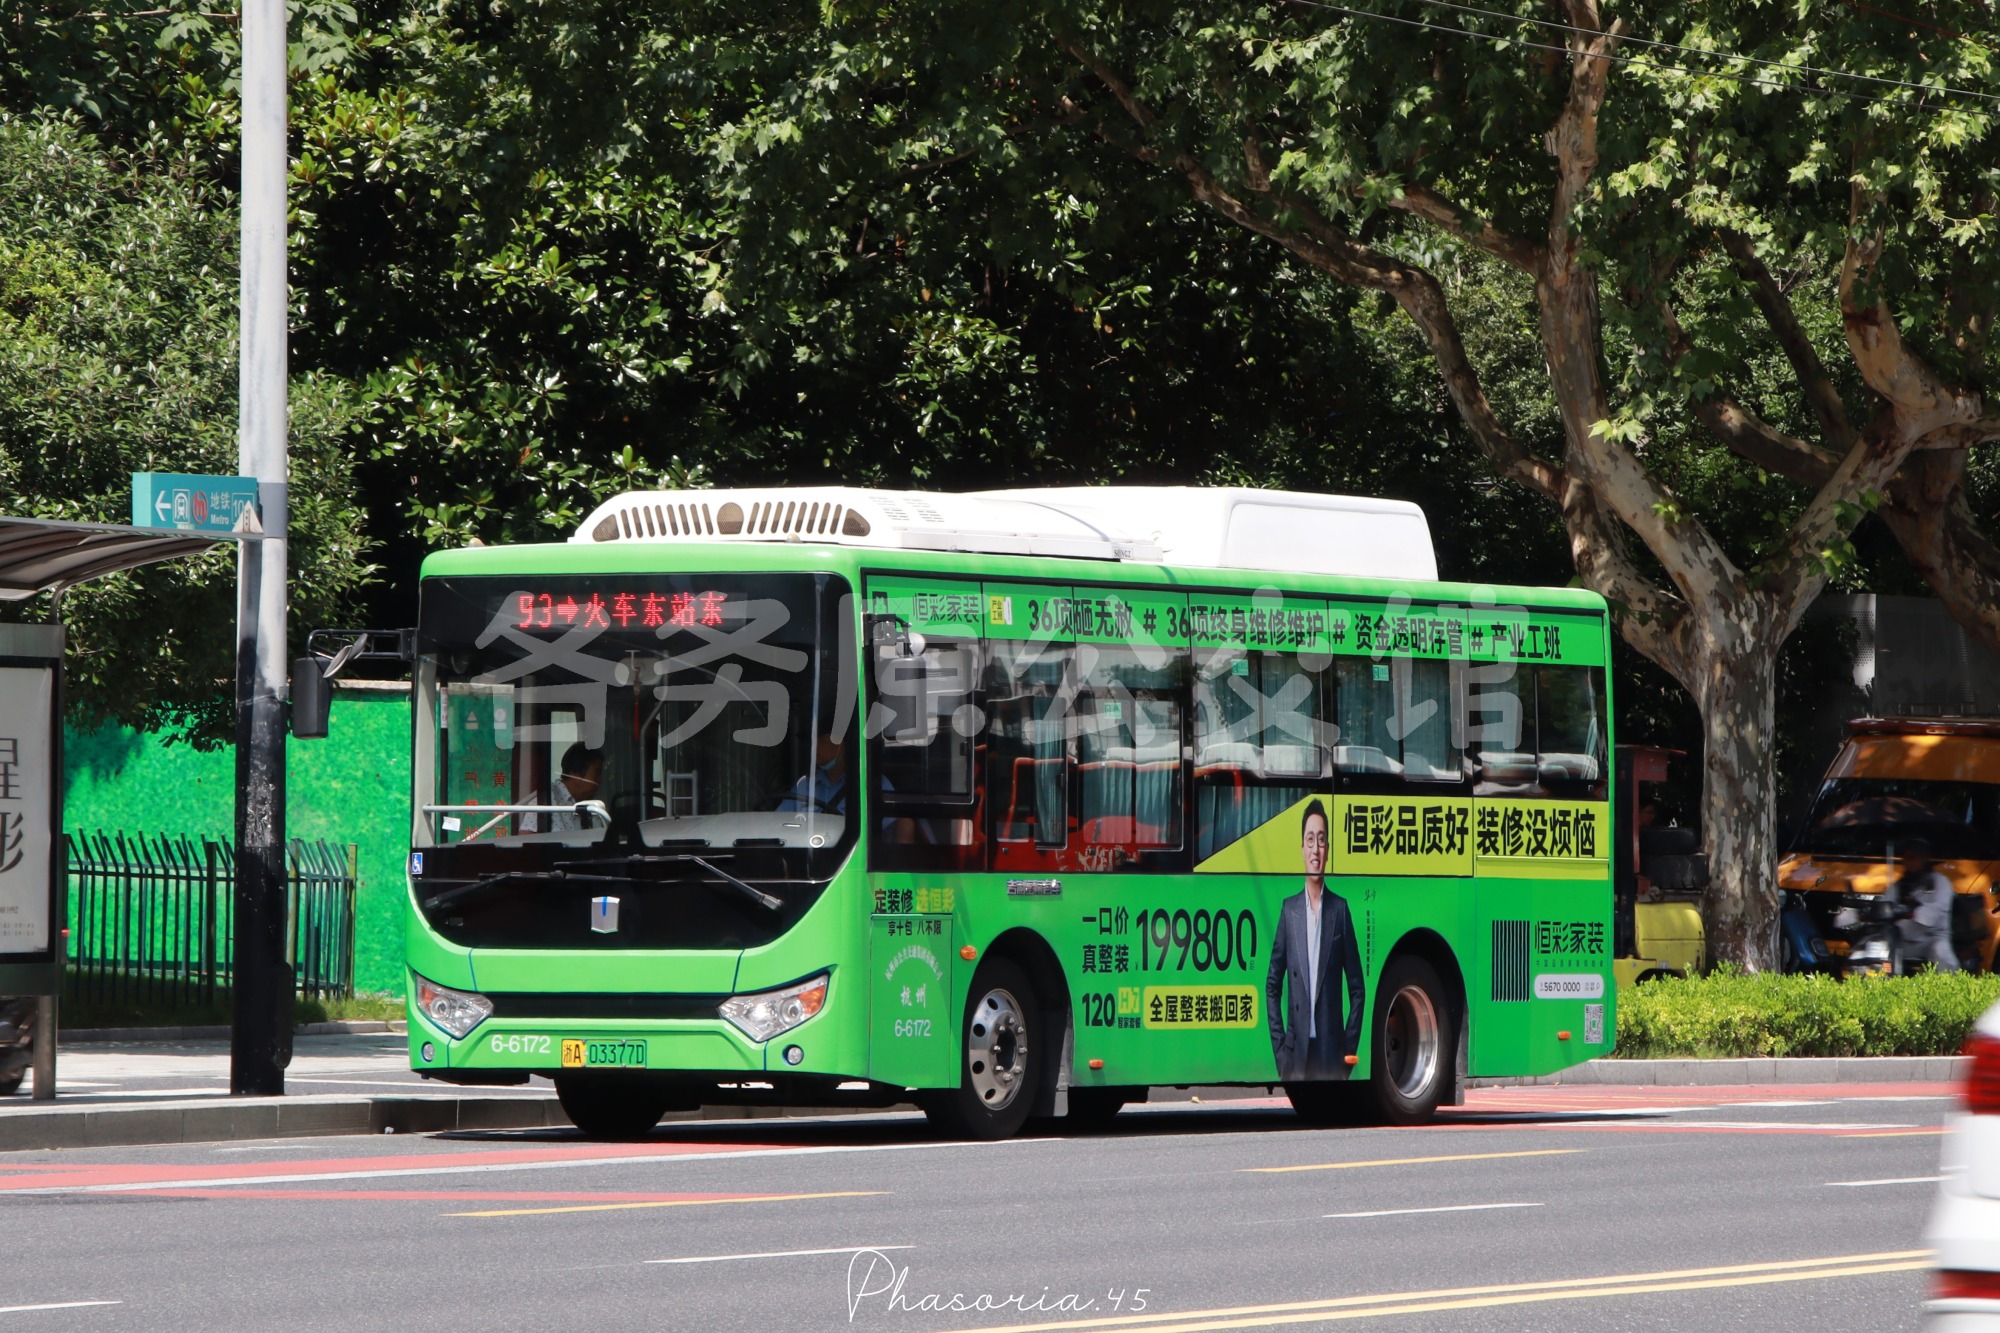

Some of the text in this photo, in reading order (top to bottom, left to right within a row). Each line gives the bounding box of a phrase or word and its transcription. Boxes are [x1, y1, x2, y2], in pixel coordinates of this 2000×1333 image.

[210, 492, 231, 510] 地铁
[210, 514, 230, 525] Metro
[519, 592, 727, 628] 93 火车东站东
[913, 594, 979, 622] 恒彩家装
[1166, 605, 1323, 648] 36项终身维修维护
[1354, 614, 1463, 656] 资金透明存管
[1491, 623, 1562, 660] 产业工班
[1344, 803, 1596, 858] 恒彩品质好 装修没烦恼
[875, 888, 913, 913] 定装修
[888, 920, 942, 936] 享十包 八不限
[1082, 906, 1129, 936] 一口价
[1535, 921, 1604, 954] 恒彩家装
[1082, 944, 1129, 974] 真整装
[1544, 982, 1561, 992] 5670
[1563, 982, 1581, 992] 0000
[1150, 994, 1253, 1024] 全屋整装搬回家
[895, 1019, 931, 1037] 6-6172
[491, 1035, 550, 1054] 6-6172
